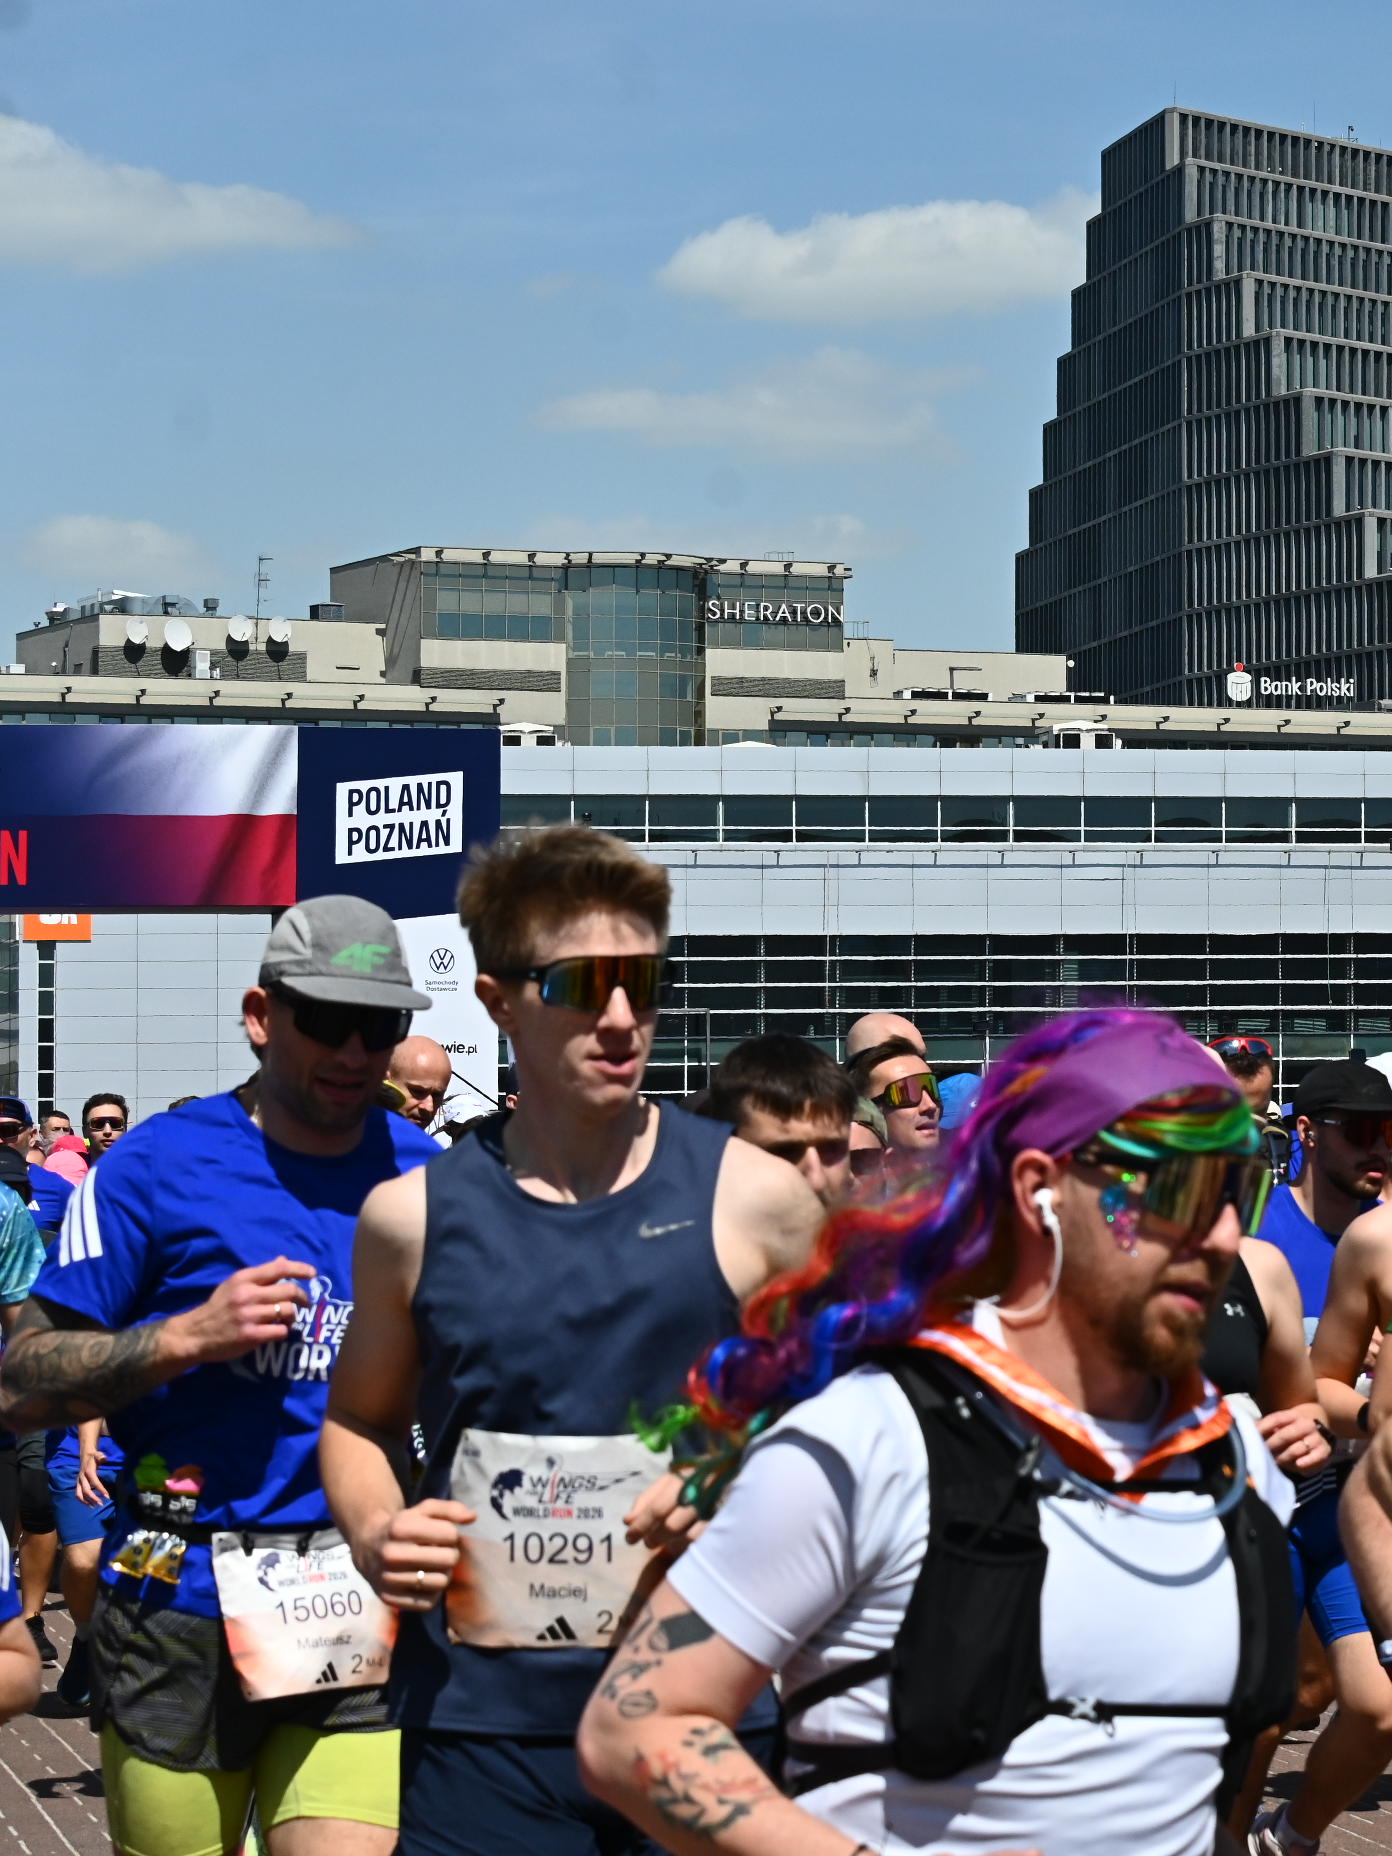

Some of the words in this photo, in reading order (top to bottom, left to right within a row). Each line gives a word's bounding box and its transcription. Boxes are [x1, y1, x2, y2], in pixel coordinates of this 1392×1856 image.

[707, 600, 843, 623] SHERATON
[1260, 676, 1302, 695] Bank
[1306, 677, 1354, 697] Polski
[347, 780, 451, 818] POLAND
[347, 809, 451, 856] POZNAŃ
[256, 1342, 340, 1382] WOR
[530, 1474, 598, 1491] WINGS
[503, 1531, 613, 1565] 10291
[529, 1583, 587, 1602] Maciej
[275, 1589, 362, 1625] 15060
[597, 1609, 614, 1635] 2
[351, 1653, 363, 1674] 2
